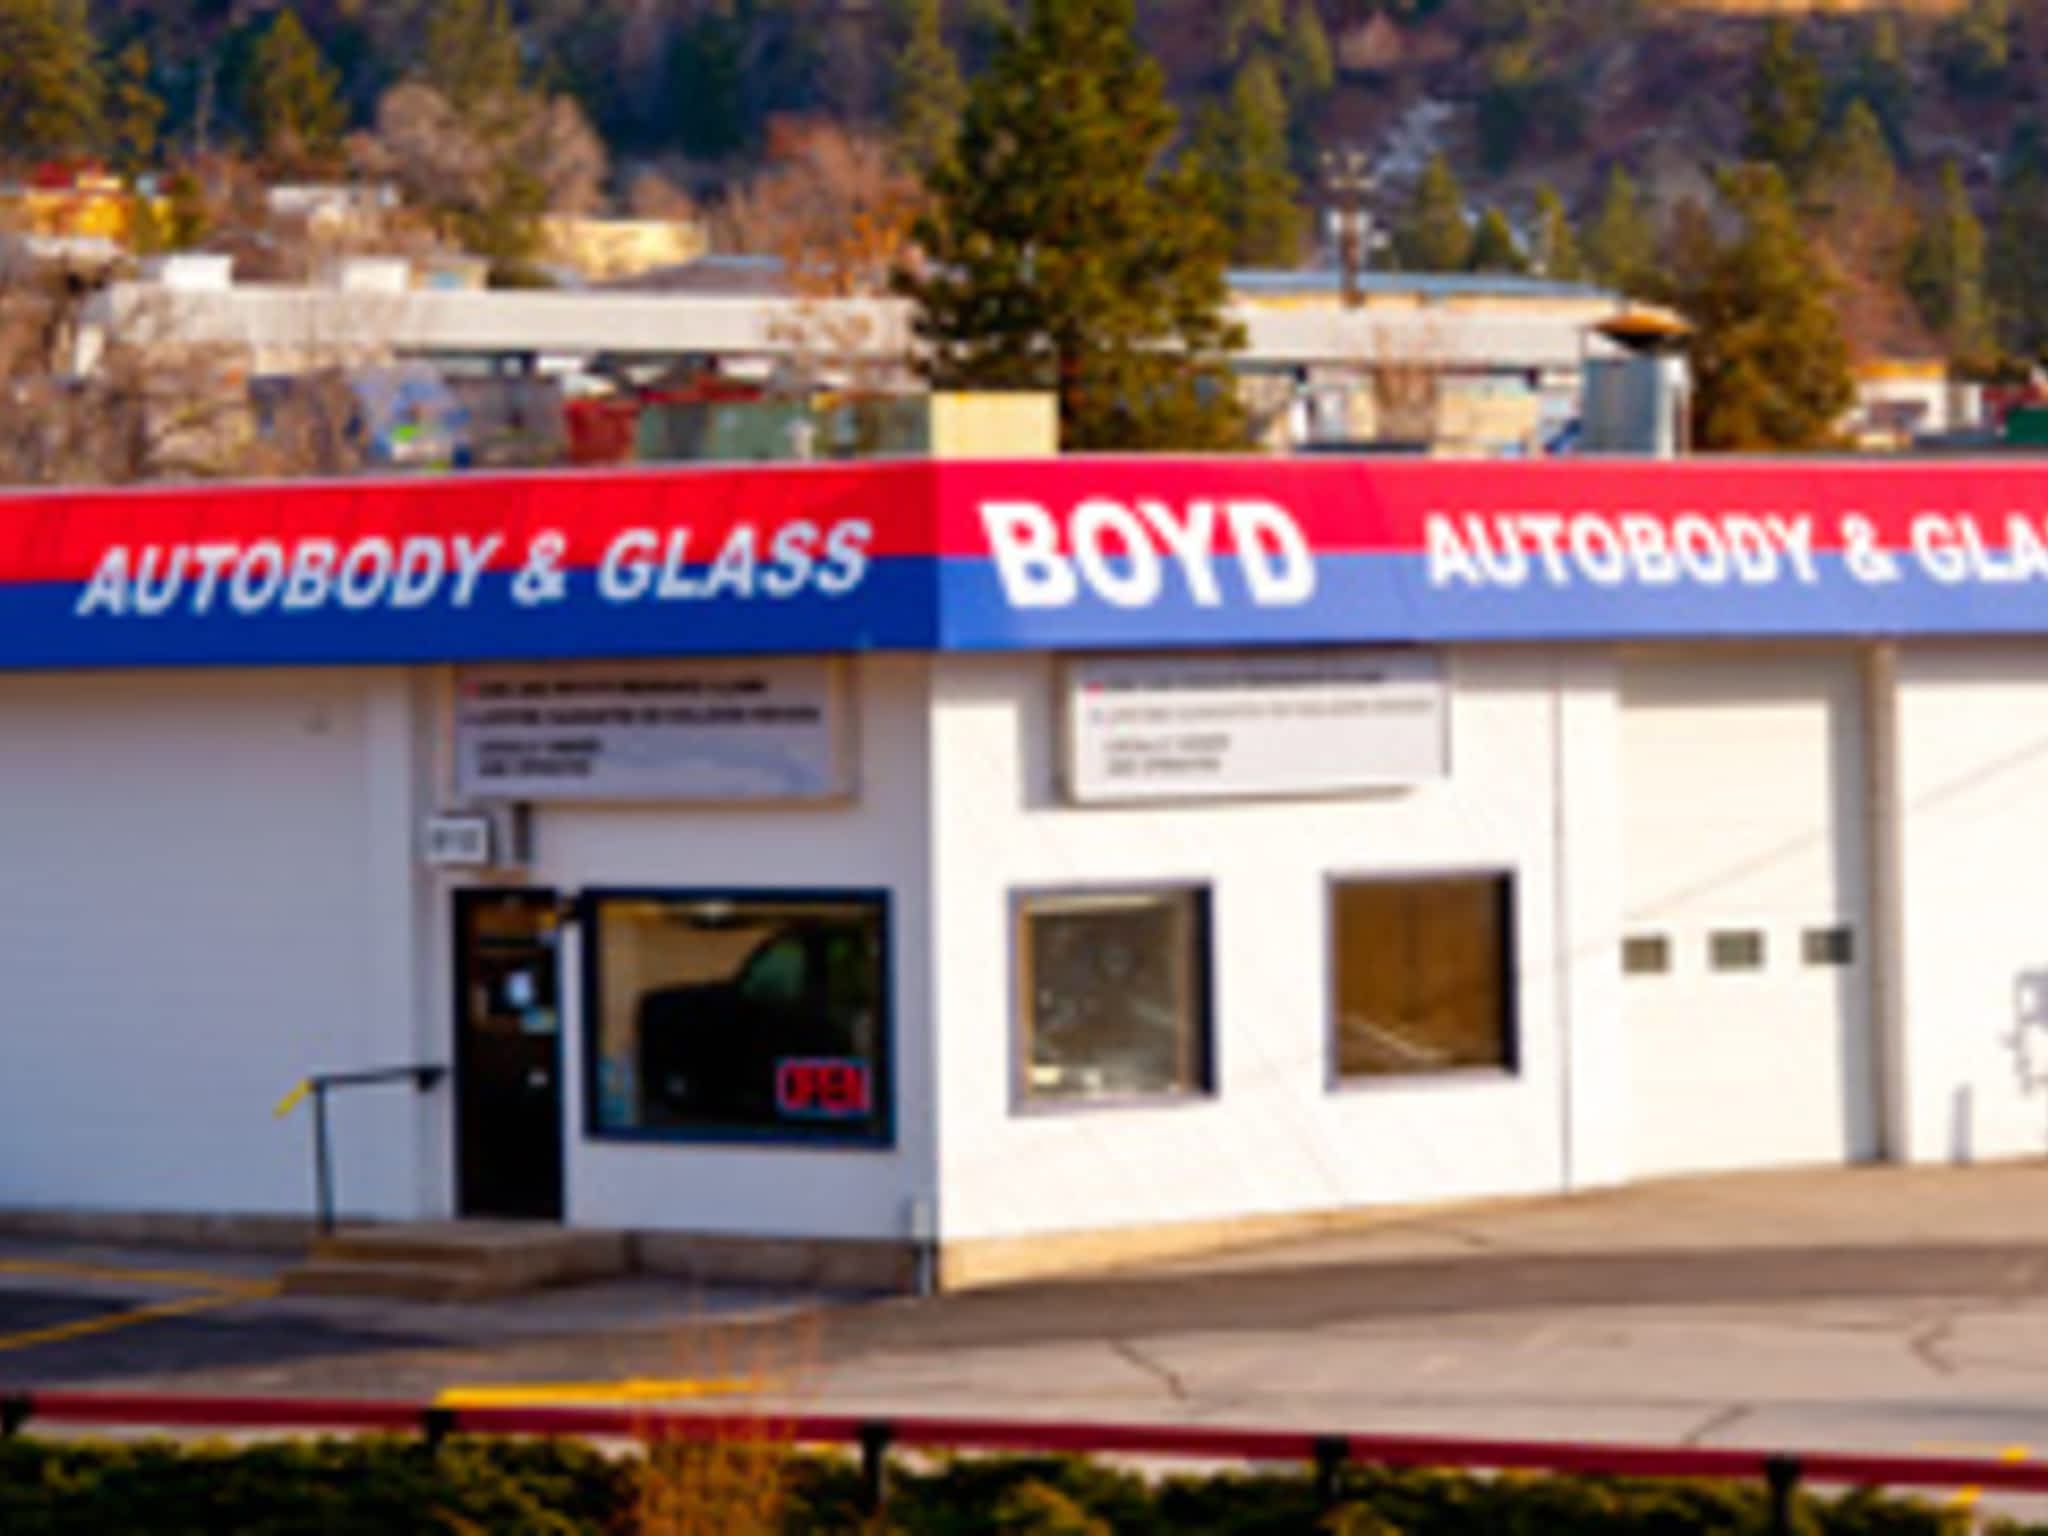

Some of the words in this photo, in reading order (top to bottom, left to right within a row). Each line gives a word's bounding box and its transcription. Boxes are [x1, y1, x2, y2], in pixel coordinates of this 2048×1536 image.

[77, 537, 500, 614] AUTOBODY
[512, 532, 565, 604] &
[599, 521, 870, 600] GLASS
[983, 503, 1316, 607] BOYD
[1428, 517, 1818, 587] AUTOBODY
[1844, 518, 1900, 584] &
[776, 1061, 869, 1111] OPEN
